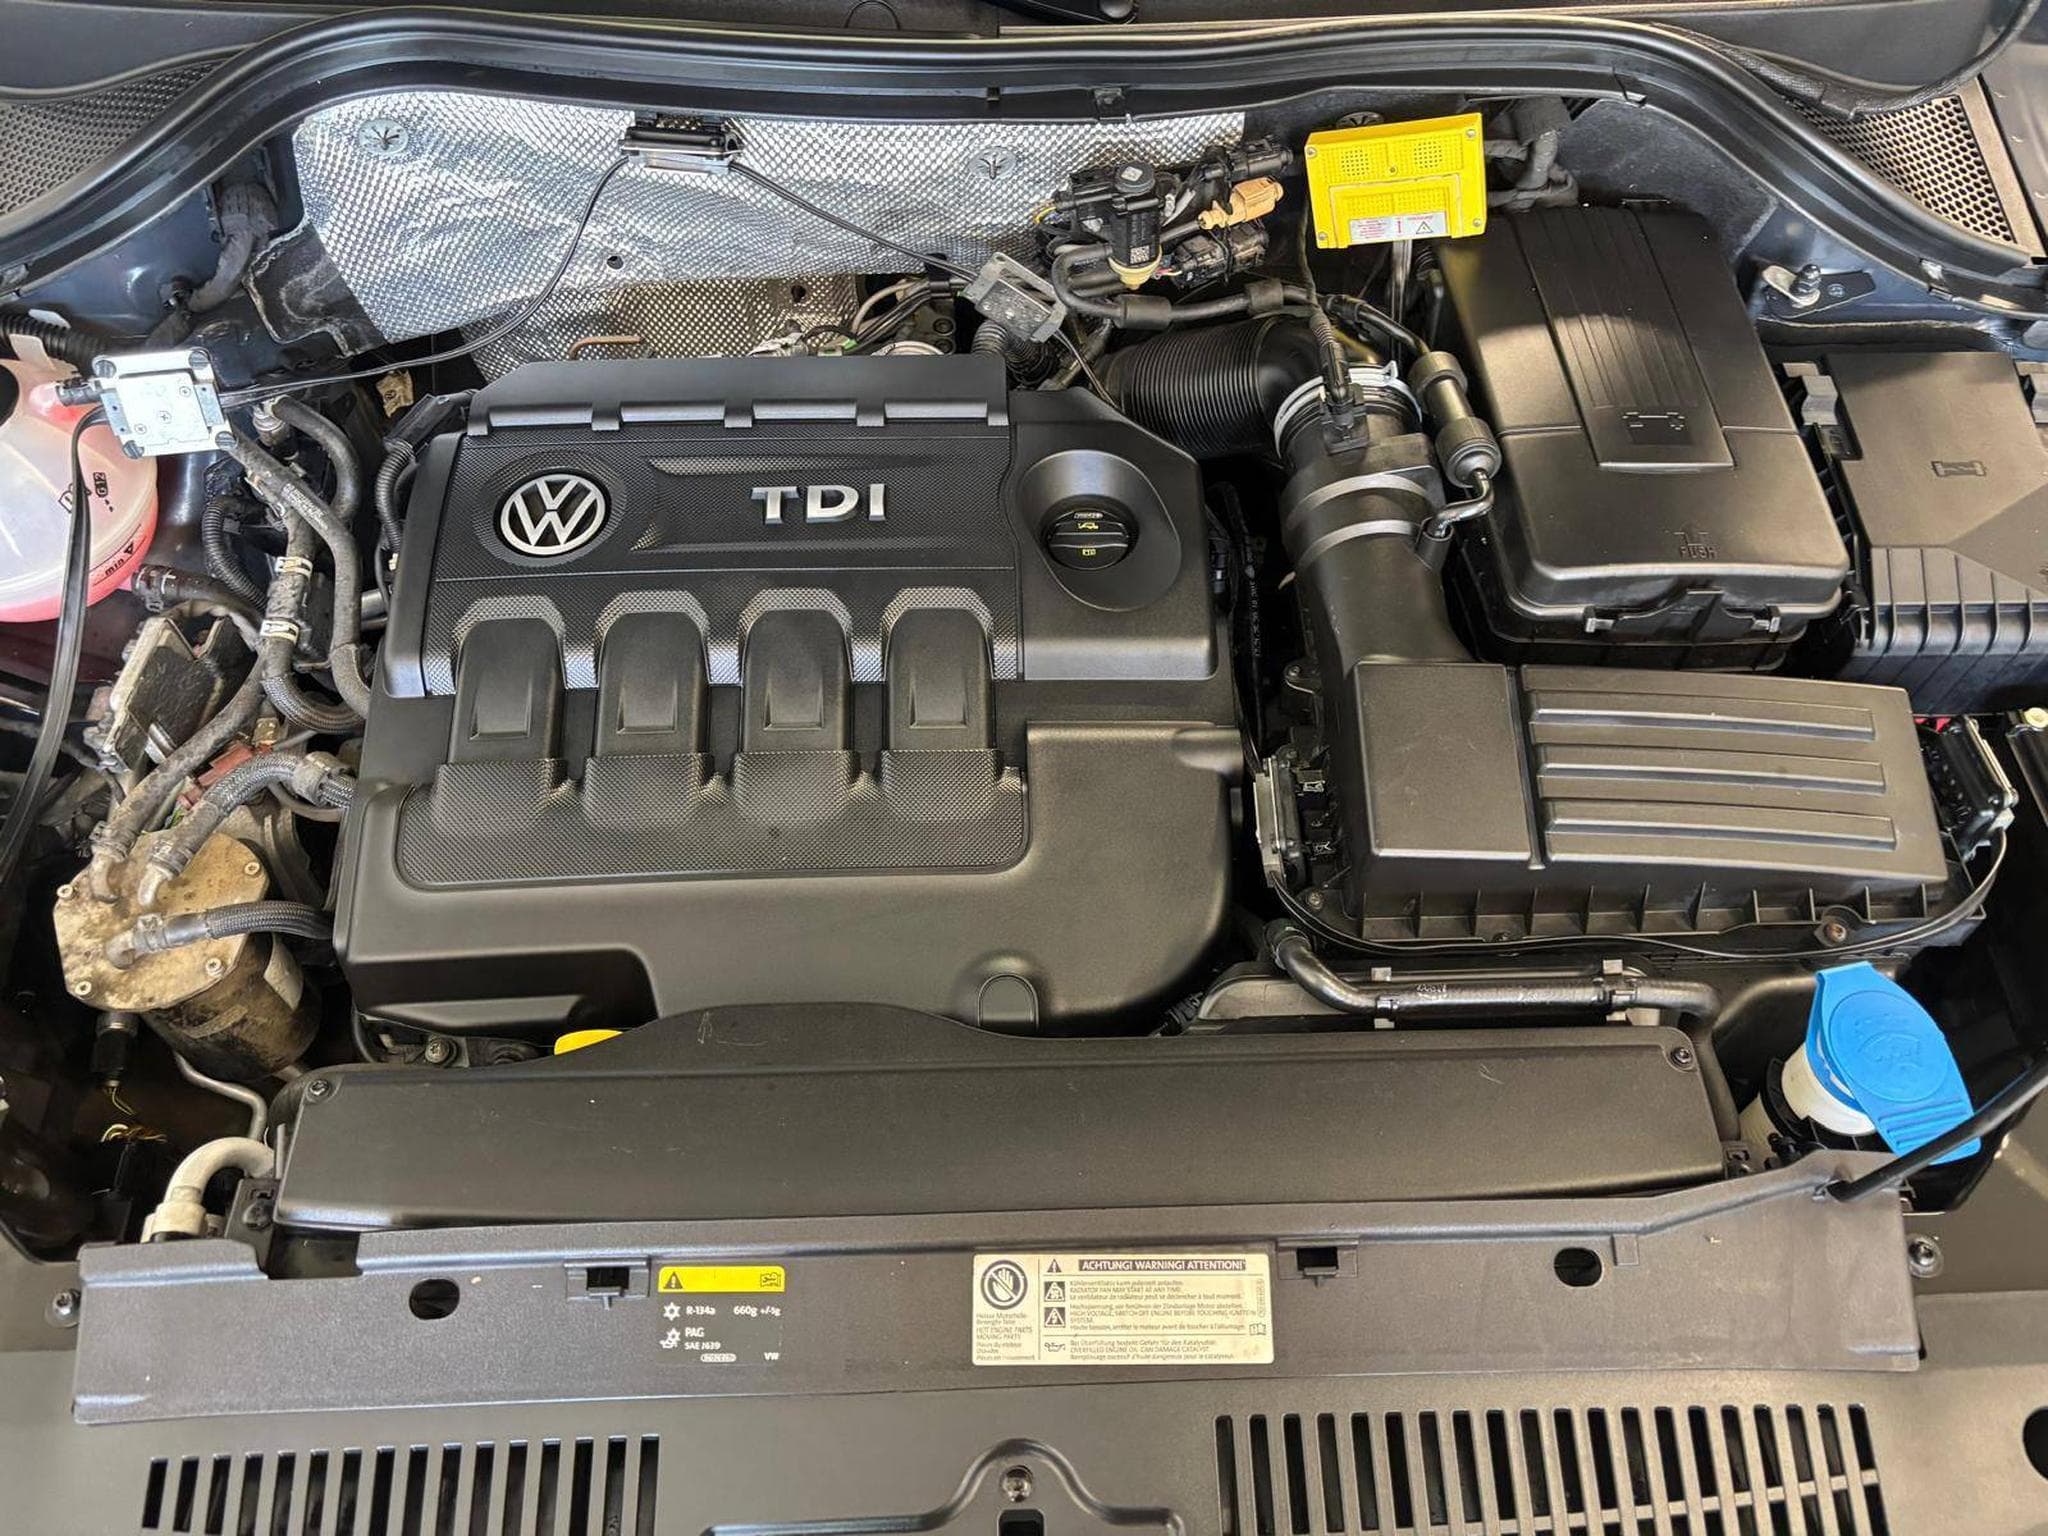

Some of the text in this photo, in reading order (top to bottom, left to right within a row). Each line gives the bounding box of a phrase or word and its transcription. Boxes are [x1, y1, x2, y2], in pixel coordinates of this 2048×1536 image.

[750, 483, 886, 524] TDI
[1680, 546, 1719, 559] PUSH
[105, 558, 125, 576] min
[1082, 1261, 1243, 1270] ACHTUNG! WARNING! ATTENTION!
[733, 1306, 758, 1317] 660g
[685, 1327, 705, 1337] PAG
[684, 1342, 700, 1350] SAE
[764, 1352, 779, 1360] VW
